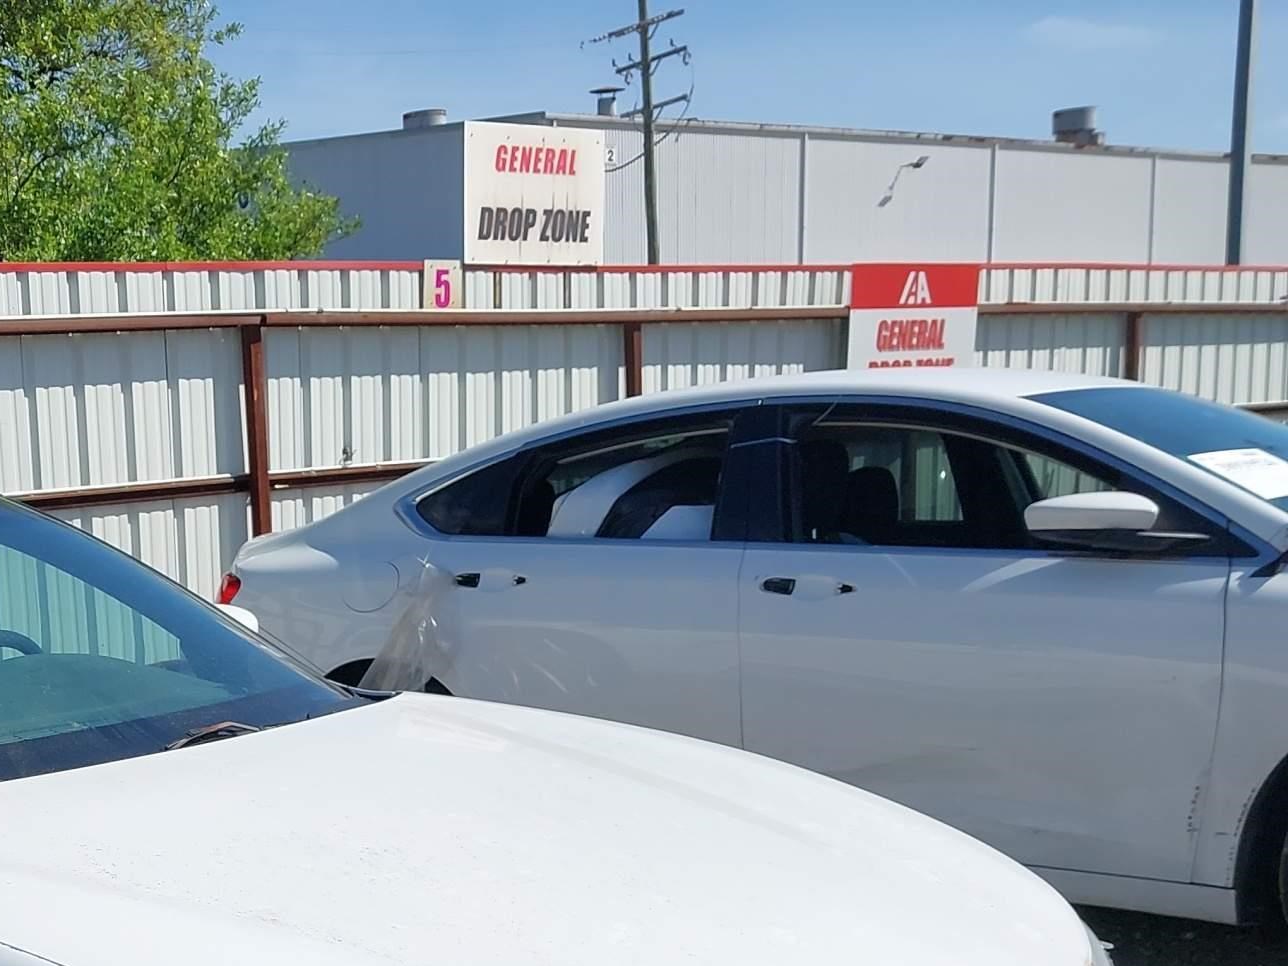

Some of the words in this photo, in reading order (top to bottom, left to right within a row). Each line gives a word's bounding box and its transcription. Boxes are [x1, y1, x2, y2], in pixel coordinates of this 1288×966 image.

[495, 144, 576, 176] GENERAL
[478, 206, 537, 242] DROP
[539, 208, 591, 243] ZONE
[435, 269, 450, 308] 5
[876, 318, 945, 352] GENERAL
